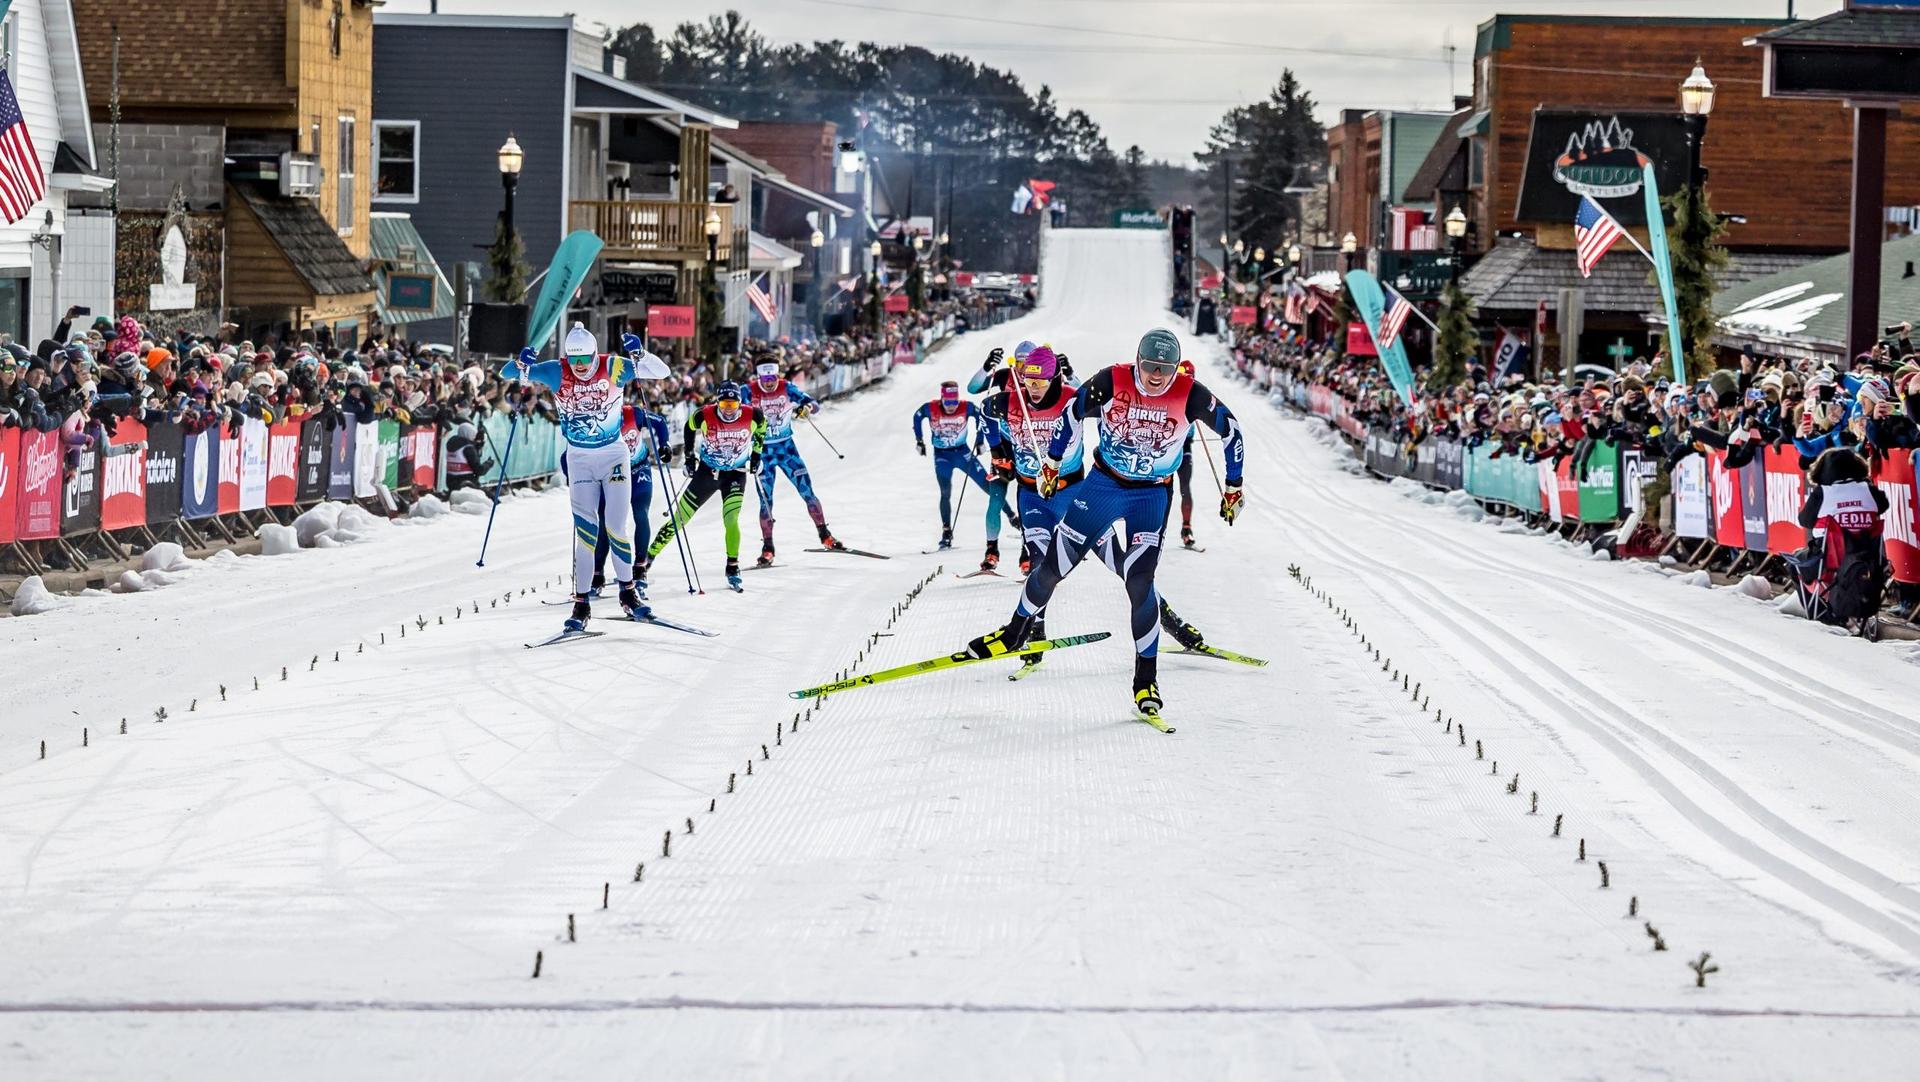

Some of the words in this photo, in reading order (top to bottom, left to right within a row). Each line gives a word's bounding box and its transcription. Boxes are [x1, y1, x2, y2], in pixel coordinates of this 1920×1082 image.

[1556, 166, 1643, 186] OUTDOO
[1128, 407, 1168, 423] BIRKIE
[587, 418, 599, 437] 2
[766, 426, 781, 438] 14
[1022, 421, 1056, 430] BRKIE
[268, 435, 298, 482] BIRKIE
[1127, 453, 1155, 475] 13
[104, 448, 143, 501] BIRKIE
[1766, 472, 1802, 530] BIRKIE
[803, 679, 857, 697] FISCHER
